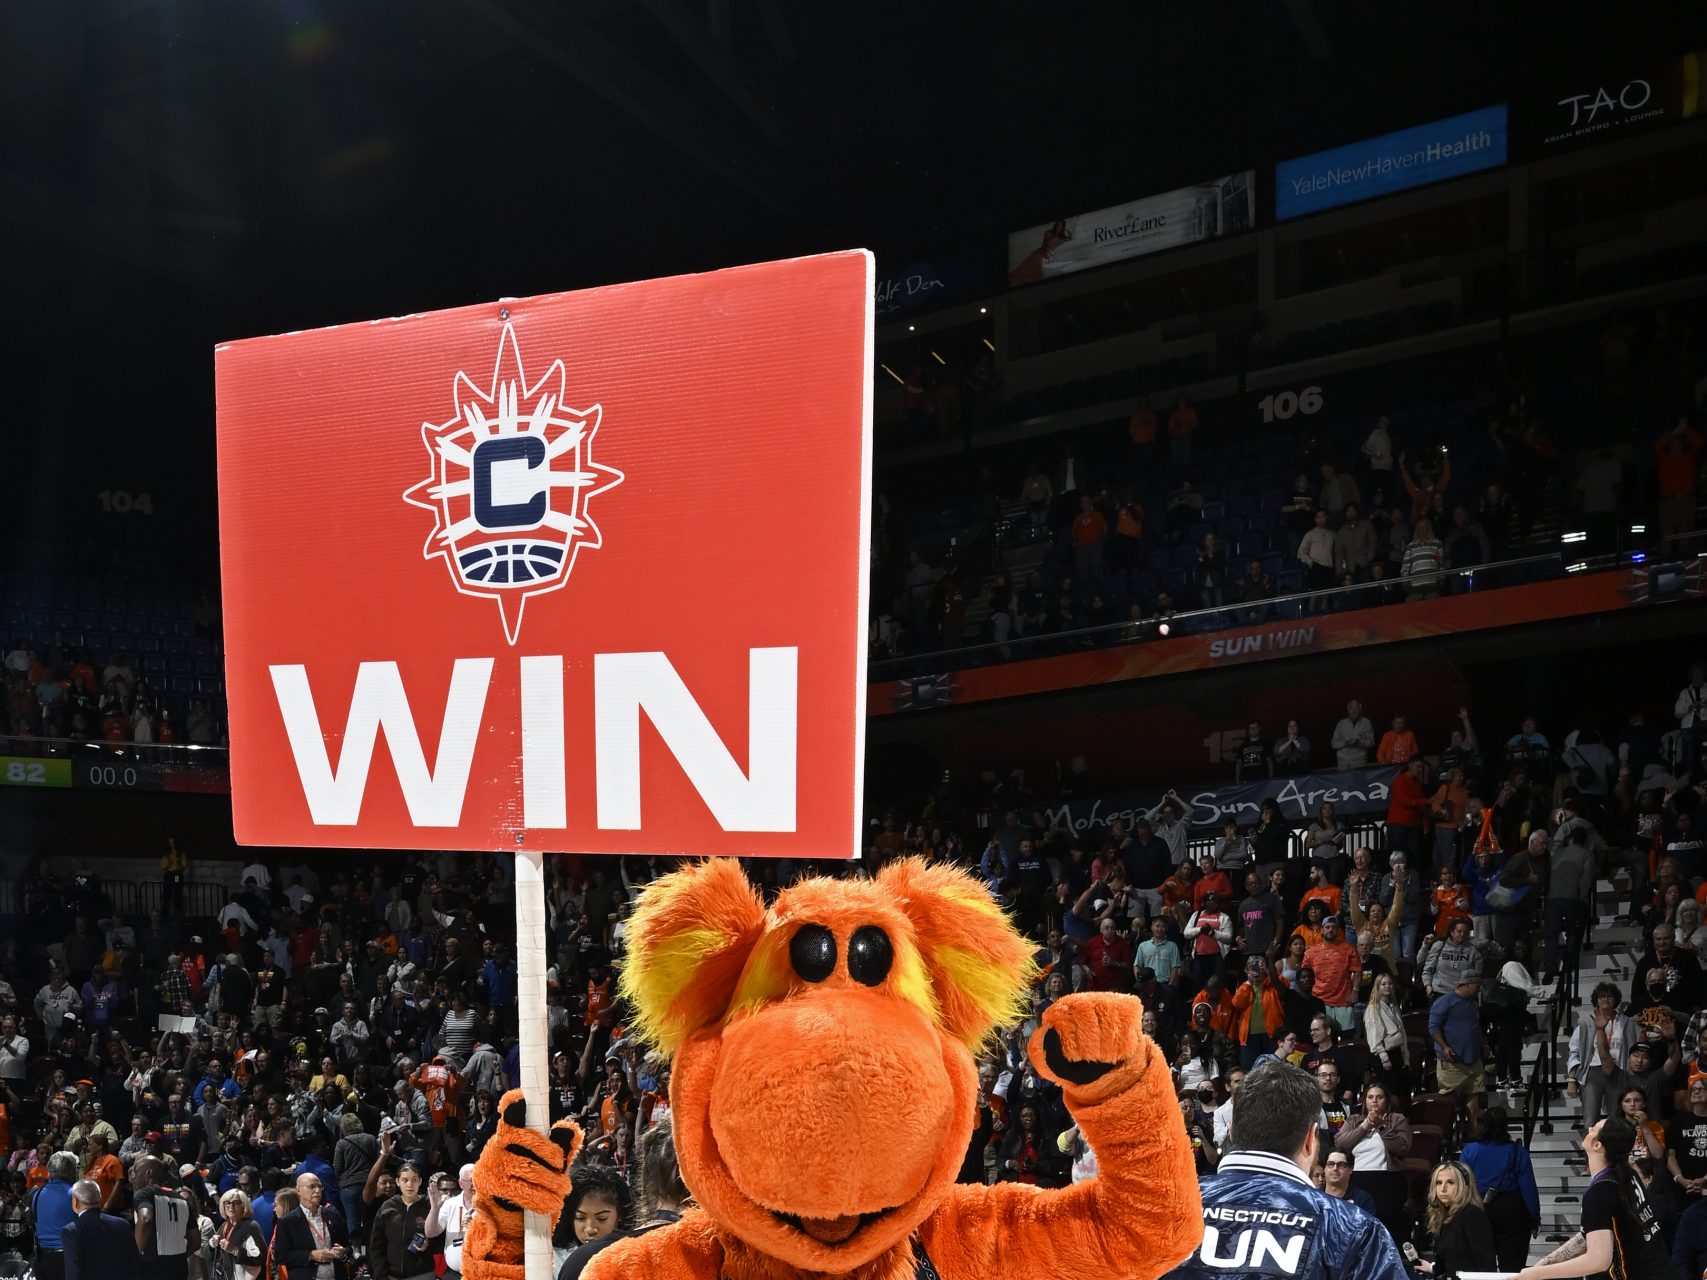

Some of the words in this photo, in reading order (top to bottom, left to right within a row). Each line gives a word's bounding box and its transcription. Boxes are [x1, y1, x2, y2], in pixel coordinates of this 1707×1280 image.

[1557, 79, 1651, 126] TAO
[1257, 385, 1325, 424] 106
[98, 489, 154, 515] 104
[1208, 635, 1262, 659] SUN
[1267, 628, 1315, 651] WIN
[269, 646, 799, 834] WIN
[7, 763, 46, 784] 82
[89, 766, 137, 786] 00.0
[1045, 799, 1154, 839] Mohega
[1190, 792, 1262, 825] Sun
[1276, 780, 1390, 817] Arena
[1202, 1207, 1313, 1228] NECTICUT
[1200, 1225, 1306, 1275] UN
